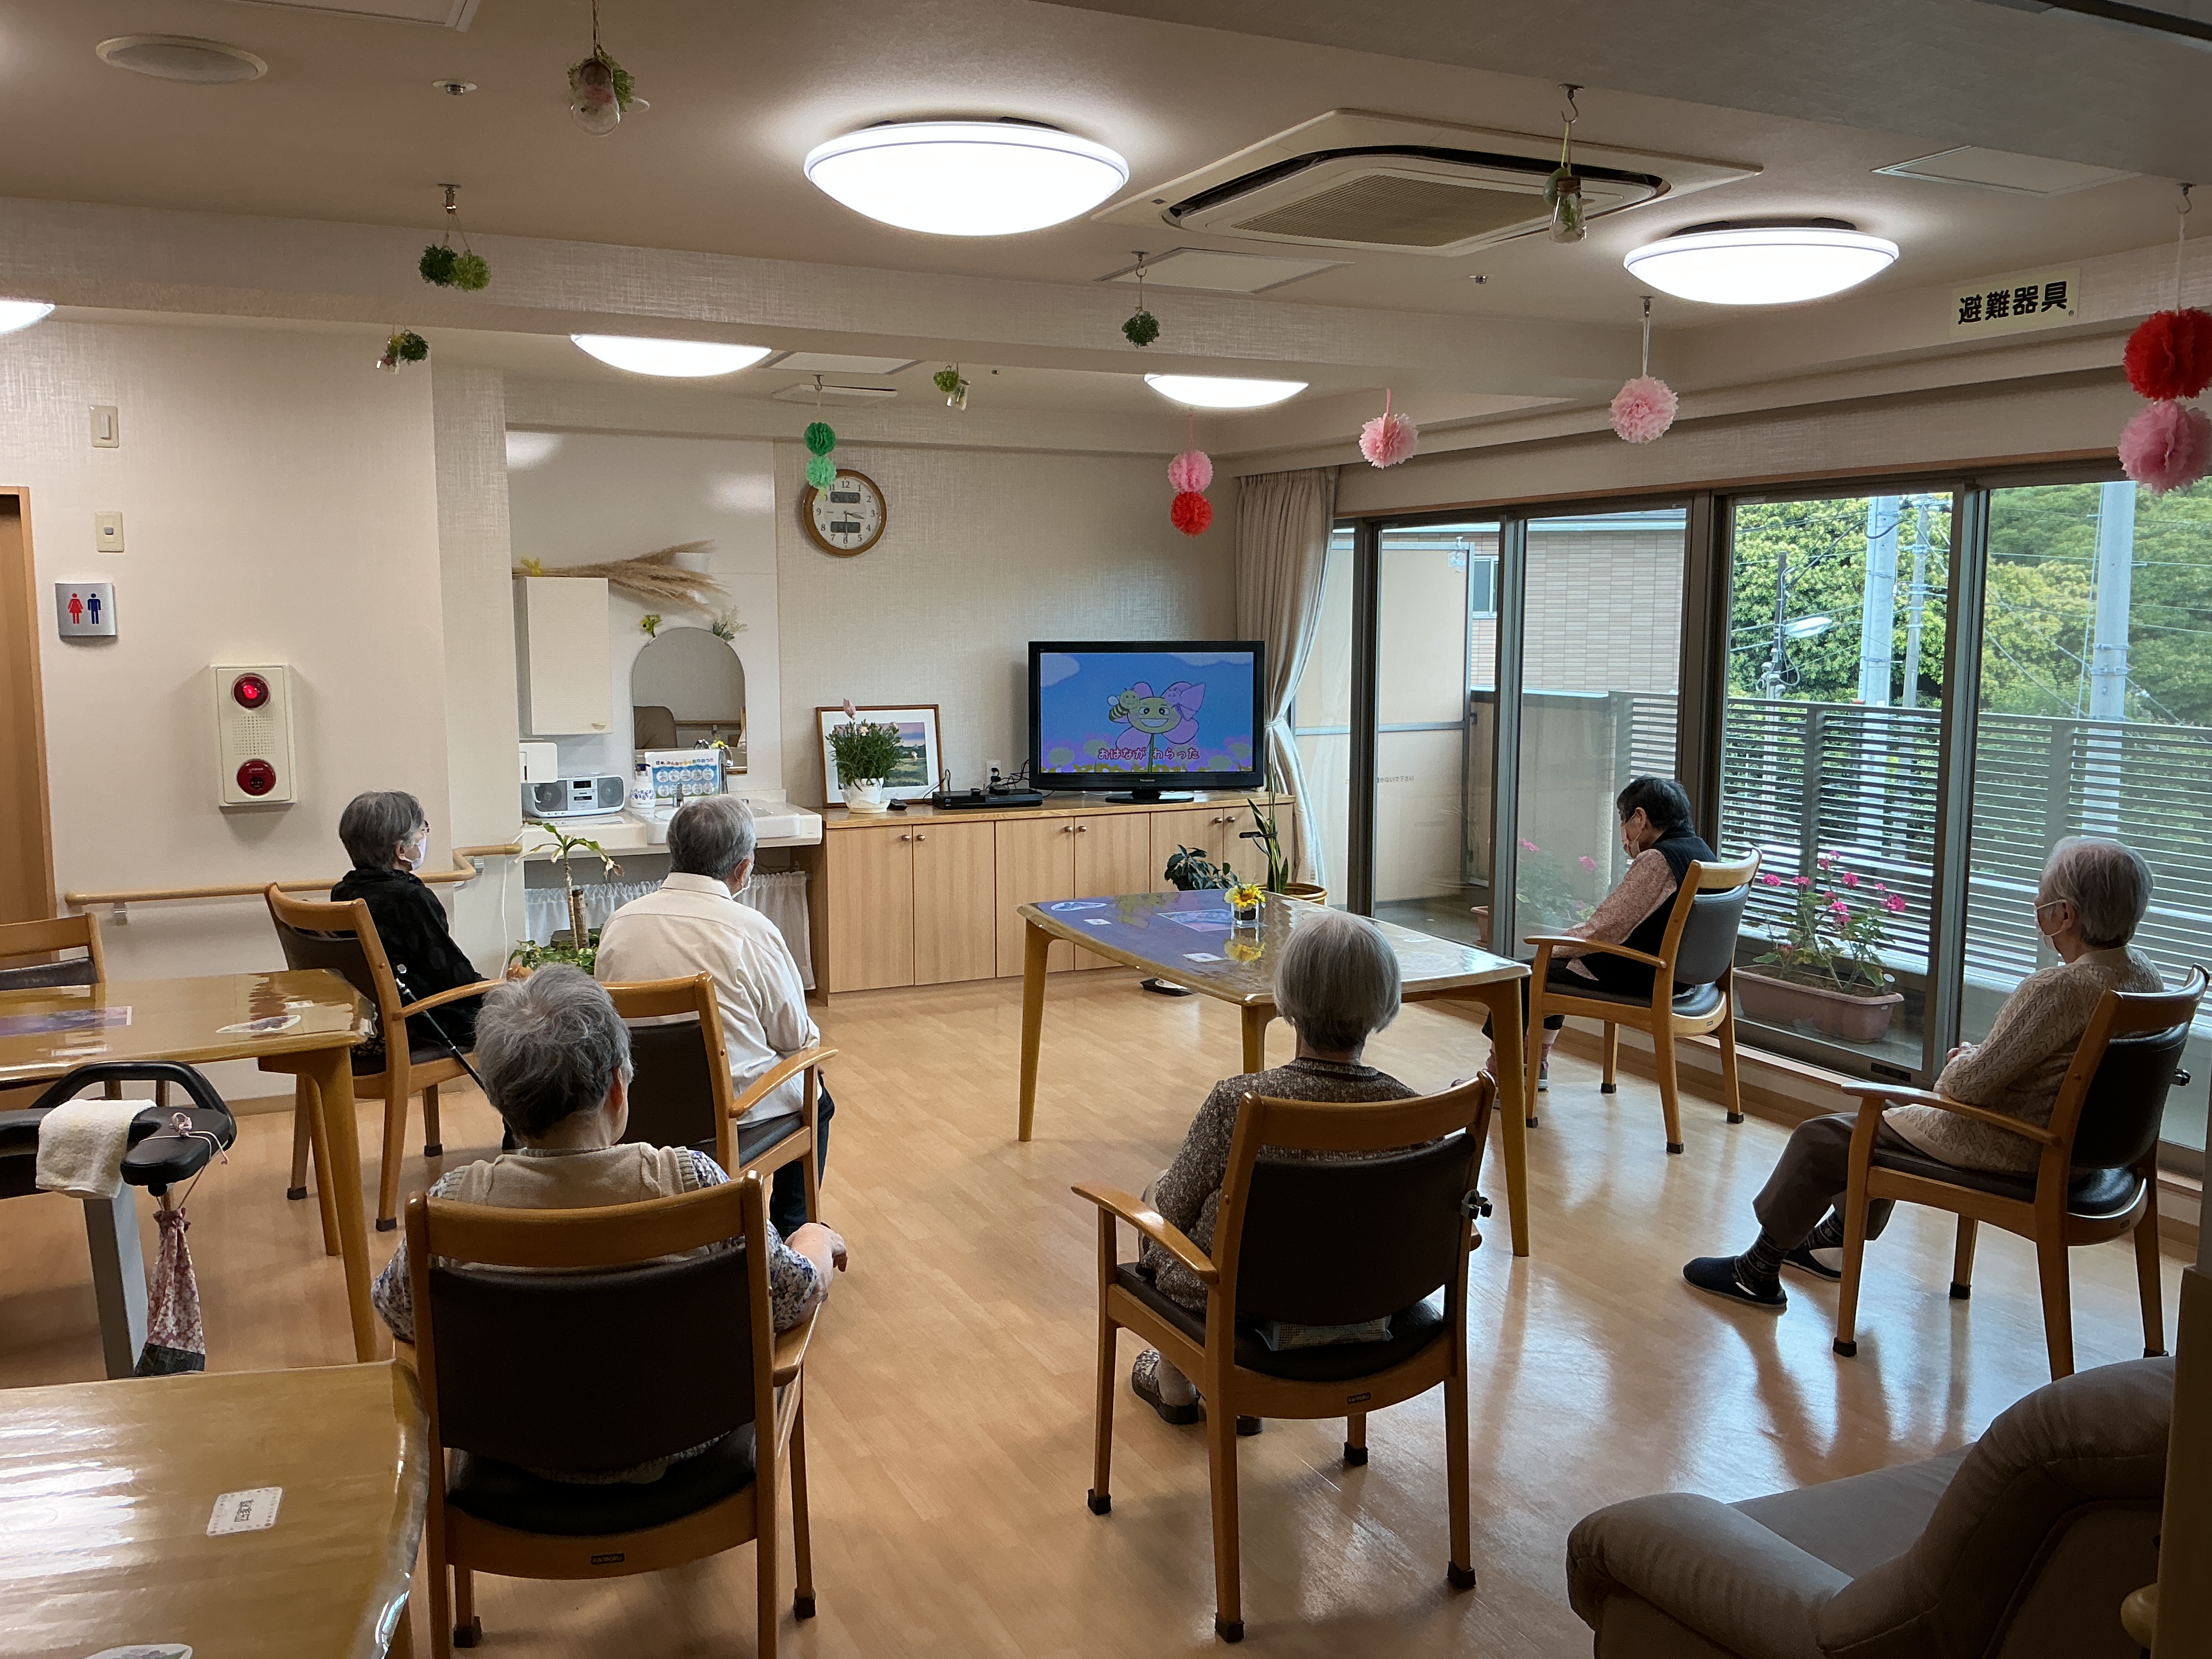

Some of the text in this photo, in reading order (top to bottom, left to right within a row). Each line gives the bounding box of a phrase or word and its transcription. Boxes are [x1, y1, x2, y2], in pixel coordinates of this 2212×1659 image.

[1957, 280, 2068, 325] 避難器具
[1098, 747, 1200, 760] おはなが わらった
